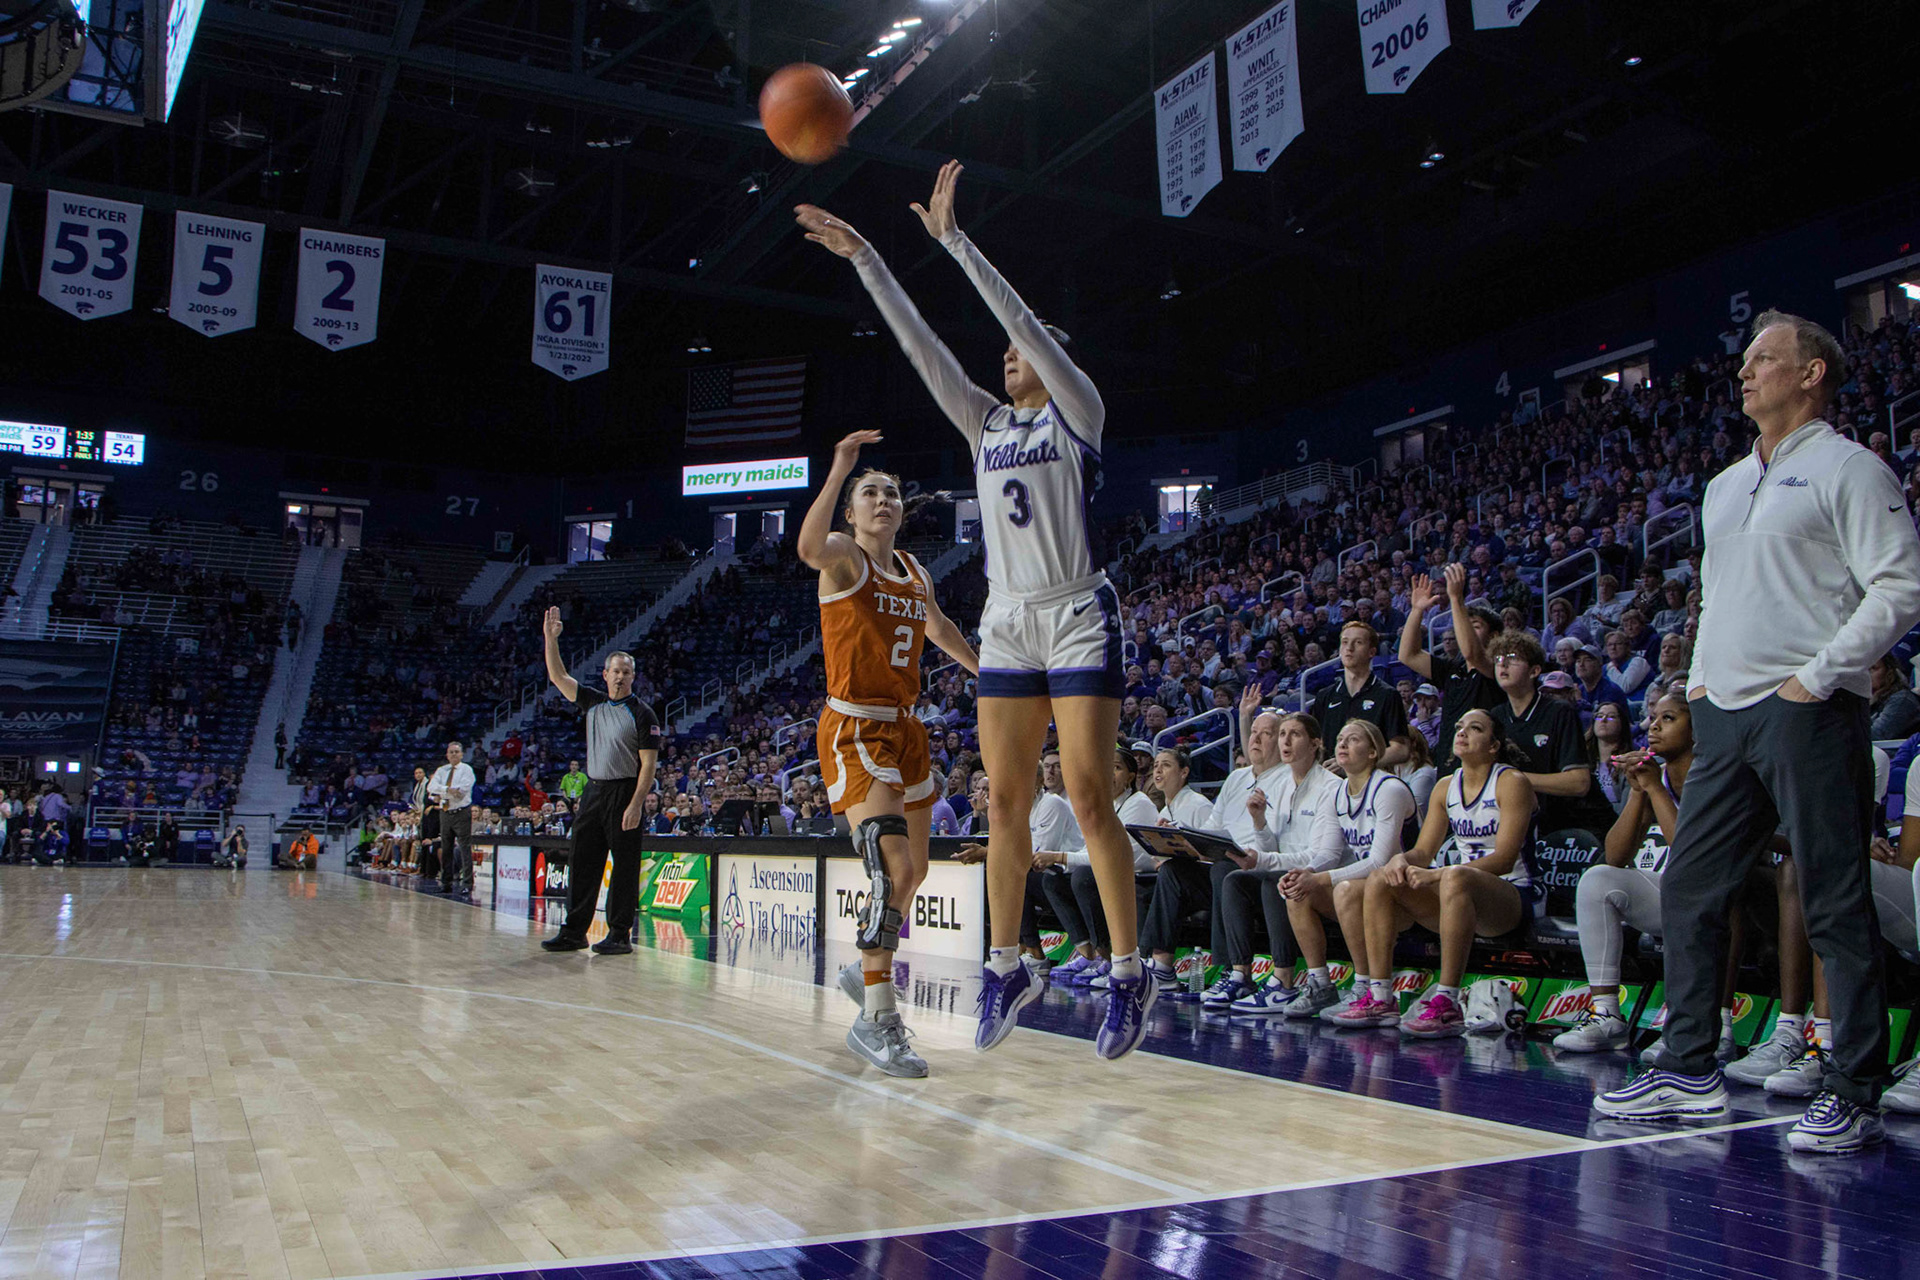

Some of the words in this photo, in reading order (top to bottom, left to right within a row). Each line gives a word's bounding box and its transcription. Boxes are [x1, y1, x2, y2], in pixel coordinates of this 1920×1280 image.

[1232, 5, 1289, 56] K-STATE
[1372, 13, 1428, 68] 2006
[1247, 48, 1275, 77] WNIT
[1160, 61, 1210, 107] K-STATE
[1264, 73, 1284, 92] 2015
[1241, 88, 1259, 106] 1999
[1265, 86, 1285, 105] 2018
[1174, 102, 1199, 129] AIAW
[1239, 101, 1259, 120] 2006
[1265, 99, 1285, 119] 2023
[1189, 124, 1206, 141] 1977
[1239, 115, 1259, 133] 2007
[1240, 128, 1259, 146] 2013
[1167, 139, 1183, 156] 1972
[1167, 152, 1183, 168] 1973
[1189, 149, 1206, 167] 1979
[1167, 164, 1183, 180] 1974
[1190, 163, 1206, 179] 1980
[1166, 176, 1183, 192] 1975
[1166, 189, 1184, 204] 1976
[63, 203, 127, 223] WECKER
[187, 223, 252, 242] LEHNING
[51, 221, 129, 281] 53
[304, 238, 380, 258] CHAMBERS
[197, 244, 233, 296] 5
[60, 284, 113, 300] 2001-05
[321, 259, 356, 312] 2
[541, 274, 583, 290] AYOKA
[586, 281, 607, 292] LEE
[187, 303, 237, 317] 2005-09
[544, 291, 595, 337] 61
[1730, 290, 1752, 323] 5
[313, 317, 359, 331] 2009-13
[537, 335, 560, 345] NCAA
[562, 338, 598, 349] DIVISION
[549, 351, 592, 363] 1/23/2022
[1495, 370, 1511, 397] 4
[31, 434, 56, 450] 59
[112, 442, 135, 458] 54
[1296, 439, 1308, 463] 3
[983, 438, 1062, 473] Wildcats
[180, 470, 219, 492] 26
[687, 471, 742, 487] merry
[746, 464, 804, 482] maids
[905, 480, 920, 500] 2
[445, 495, 480, 517] 27
[625, 499, 634, 519] 1
[1002, 478, 1033, 529] 3
[890, 624, 914, 667] 2
[1535, 840, 1598, 865] Capitol
[660, 863, 681, 880] Mtn
[749, 861, 814, 894] Ascension
[836, 889, 872, 919] TAC
[916, 895, 961, 930] BELL
[749, 901, 769, 931] Via
[771, 903, 817, 935] Christi
[1537, 991, 1594, 1022] LIBM
